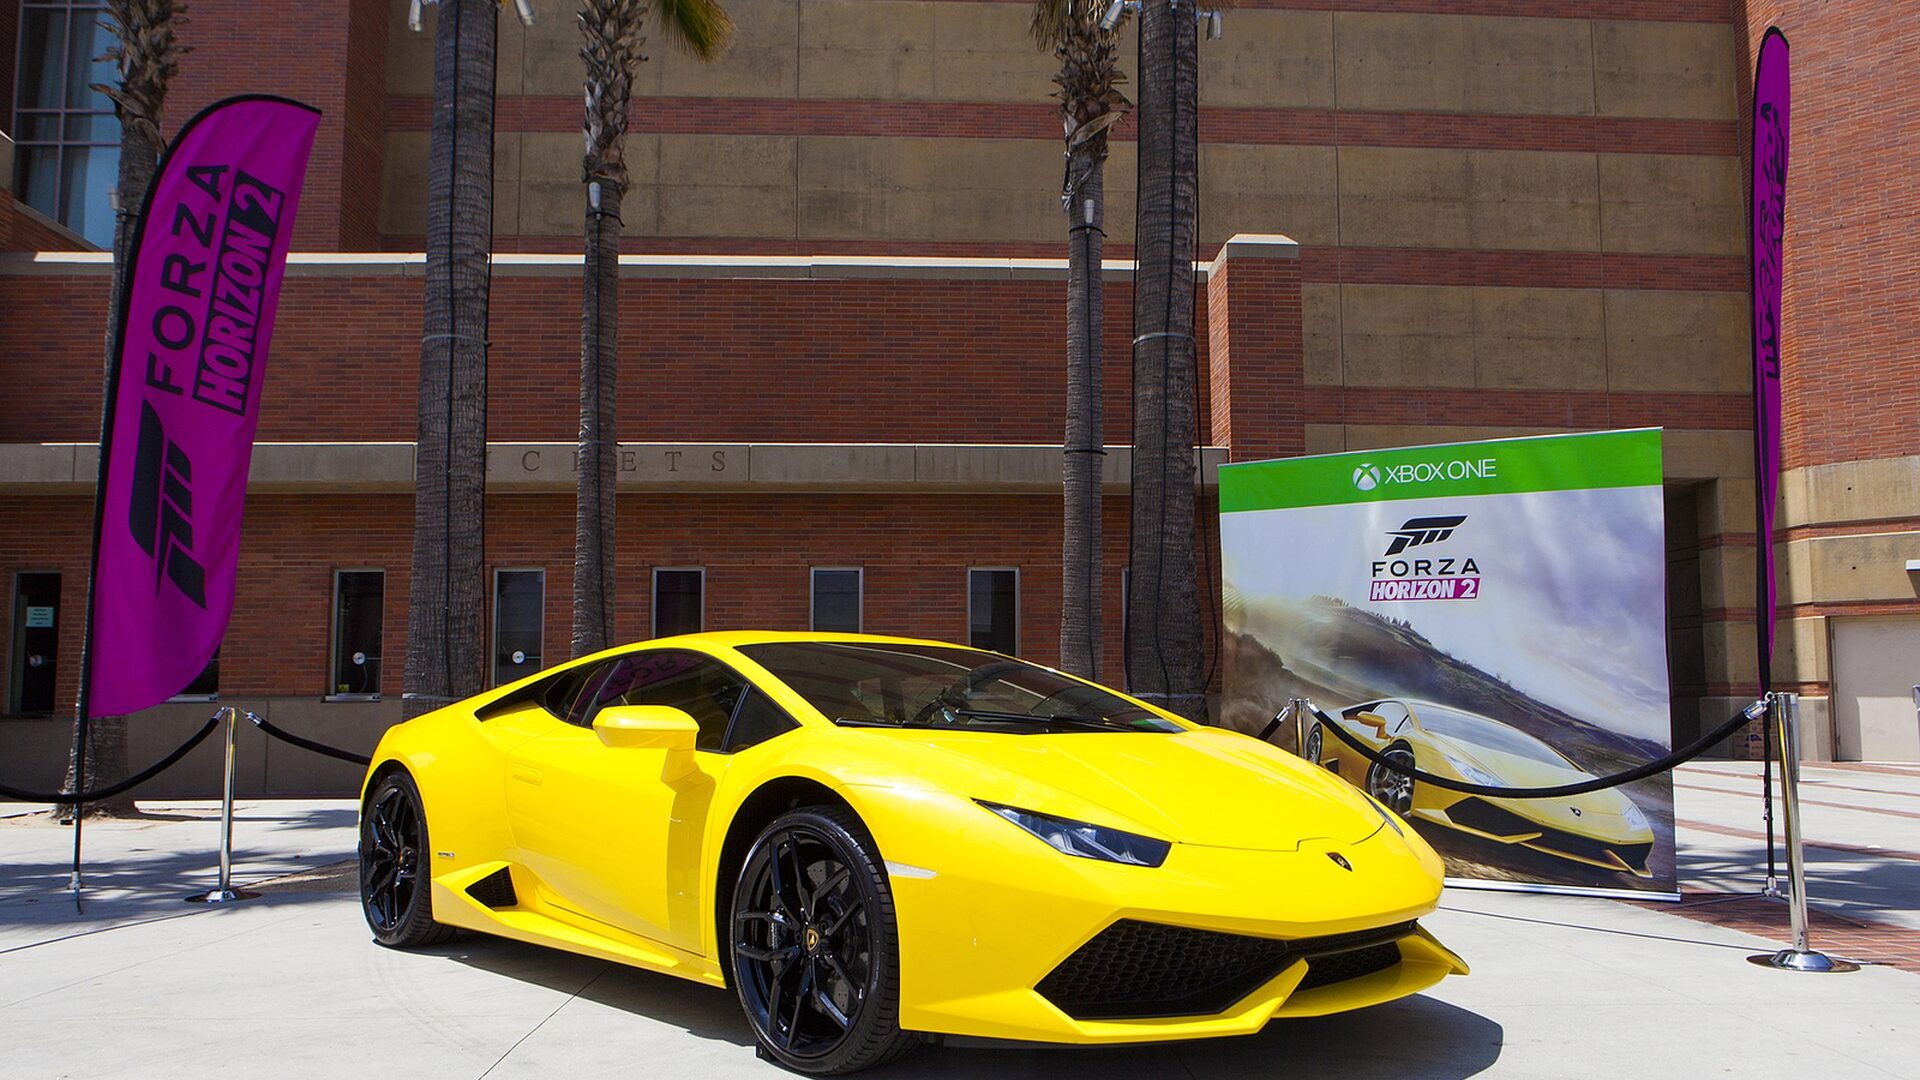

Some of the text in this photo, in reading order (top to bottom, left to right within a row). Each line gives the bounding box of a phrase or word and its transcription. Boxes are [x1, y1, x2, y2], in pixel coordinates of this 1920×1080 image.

[145, 164, 230, 396] FORZA
[197, 182, 282, 411] HORIZON 2
[1384, 458, 1497, 485] XBOX ONE
[1371, 558, 1481, 578] FORZA
[1371, 578, 1477, 600] HORIZON 2
